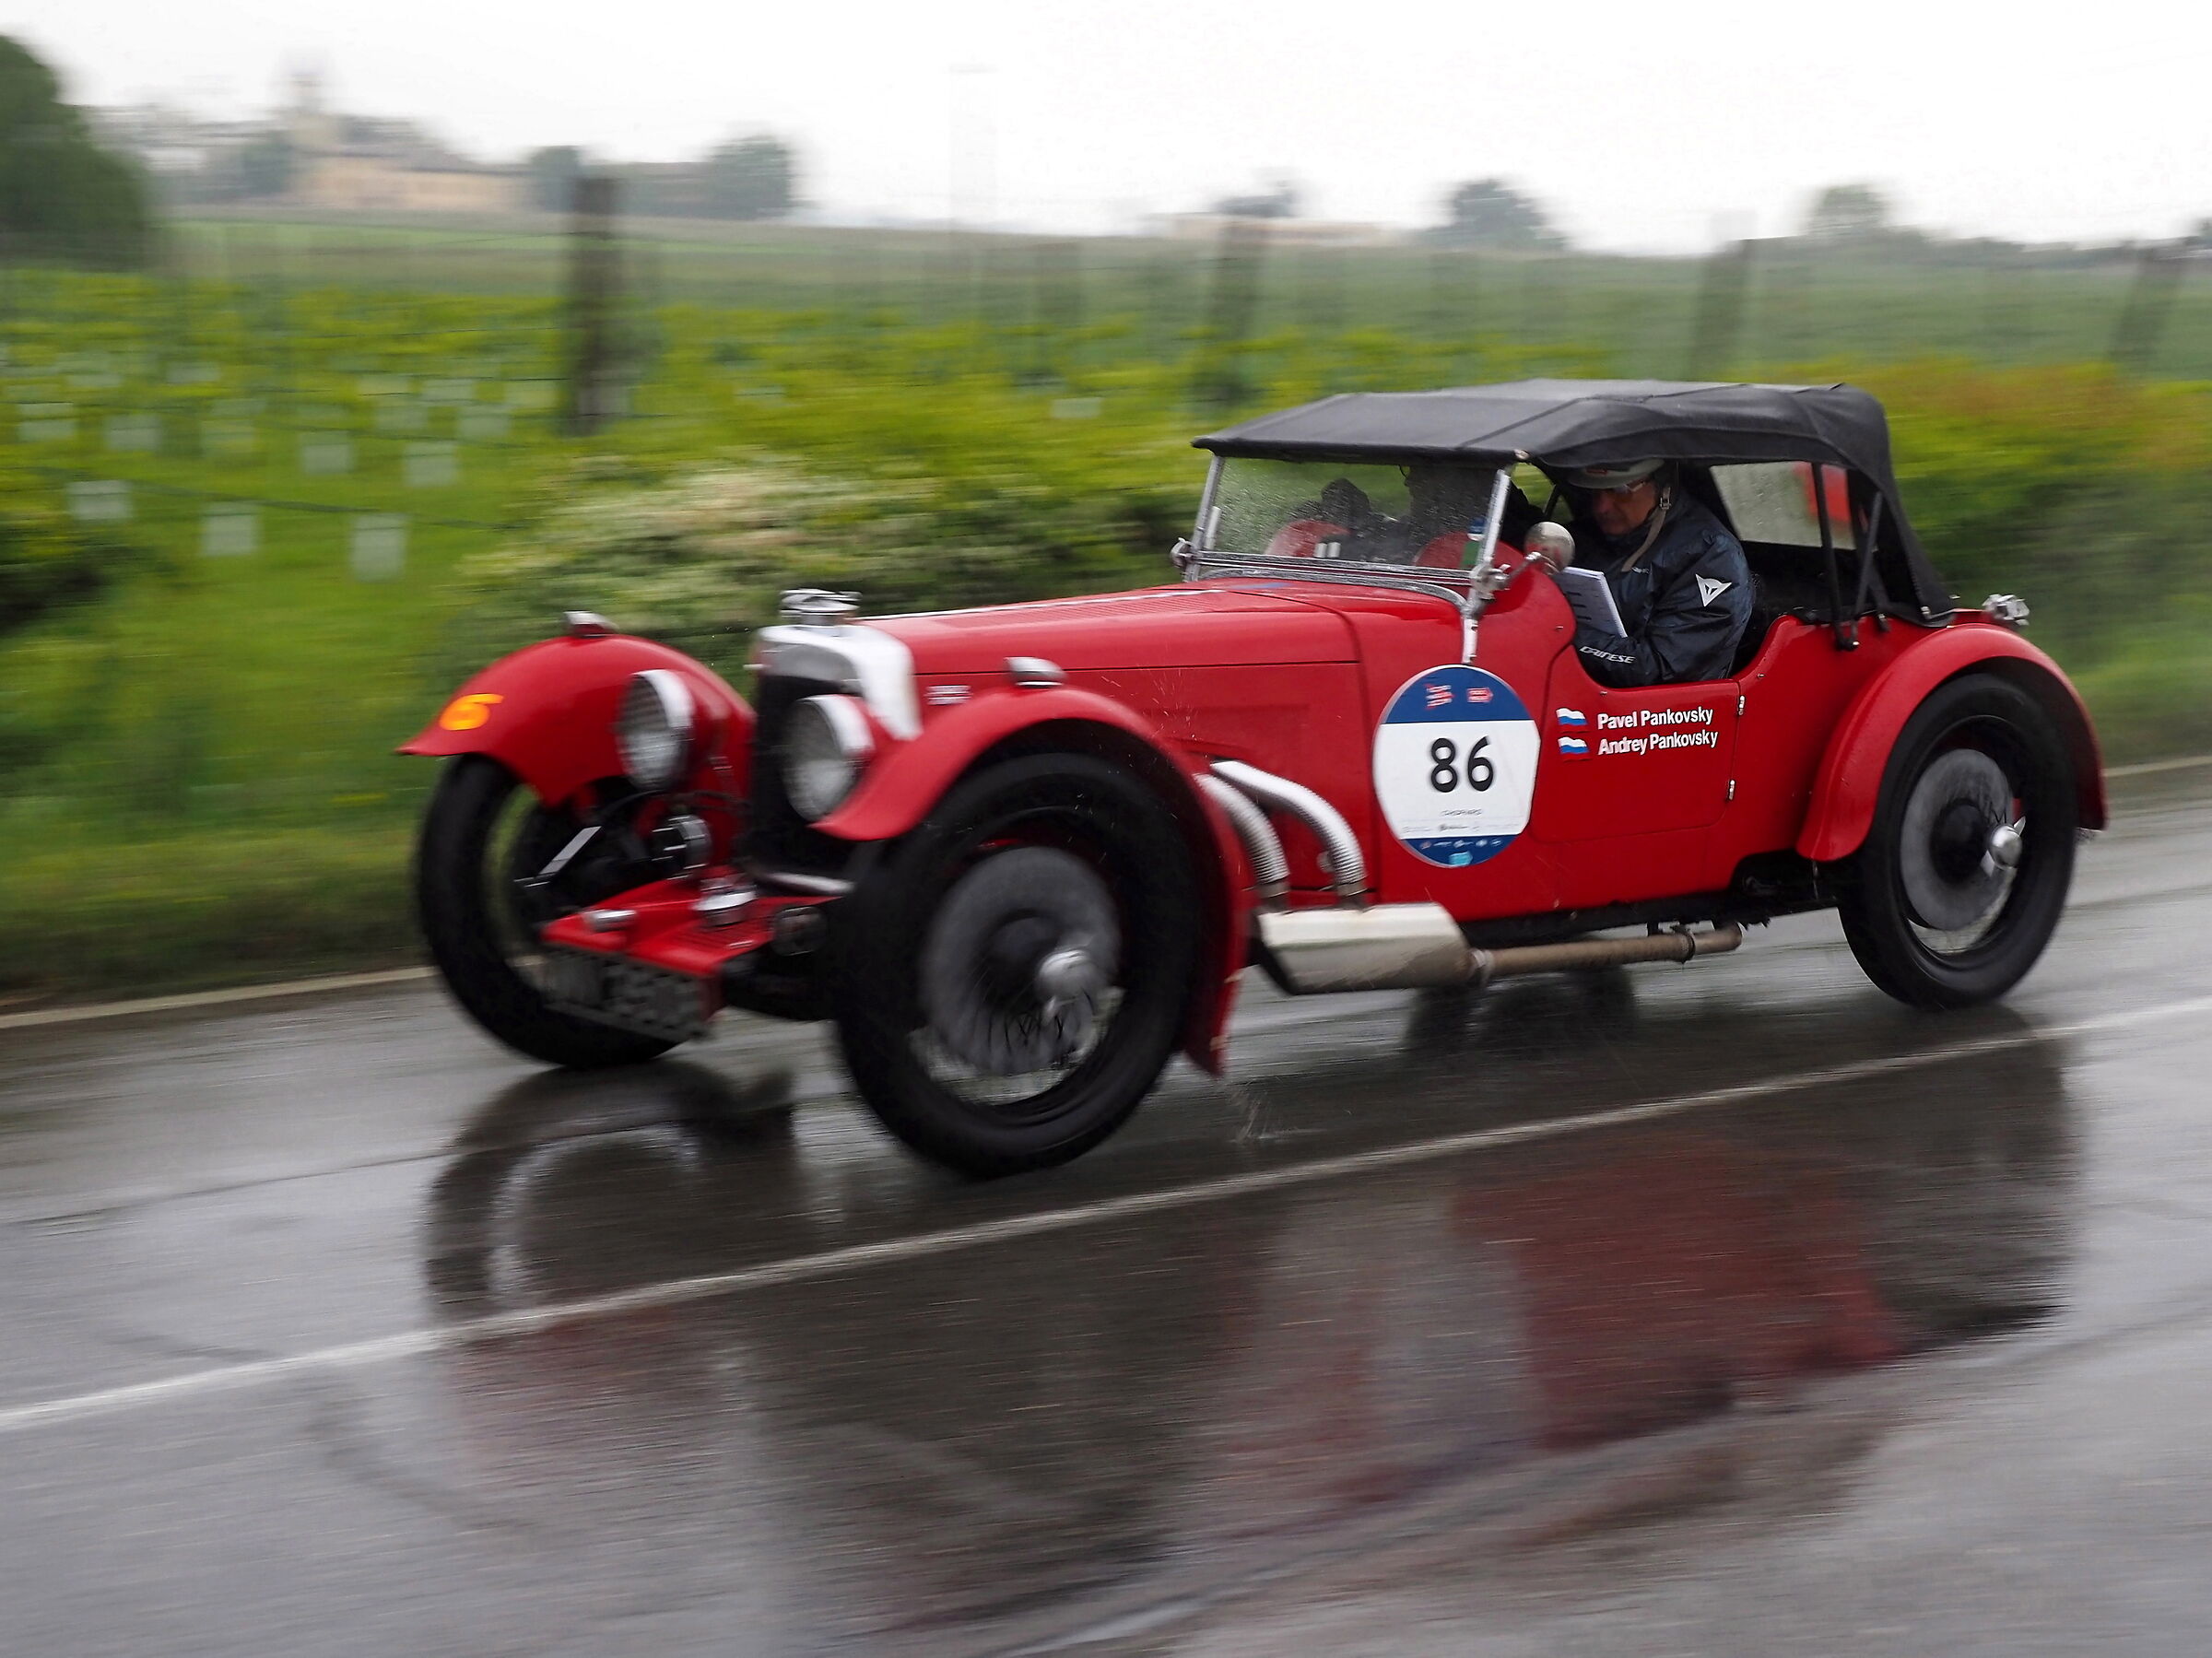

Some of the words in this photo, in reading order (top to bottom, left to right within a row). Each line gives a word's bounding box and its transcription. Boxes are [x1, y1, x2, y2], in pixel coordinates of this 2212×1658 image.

[439, 693, 504, 731] 6
[1597, 712, 1637, 730] Pavel
[1641, 706, 1713, 725] Pankovsky
[1597, 736, 1648, 756] Andrey
[1649, 729, 1719, 749] Pankovsky
[1430, 736, 1494, 793] 86
